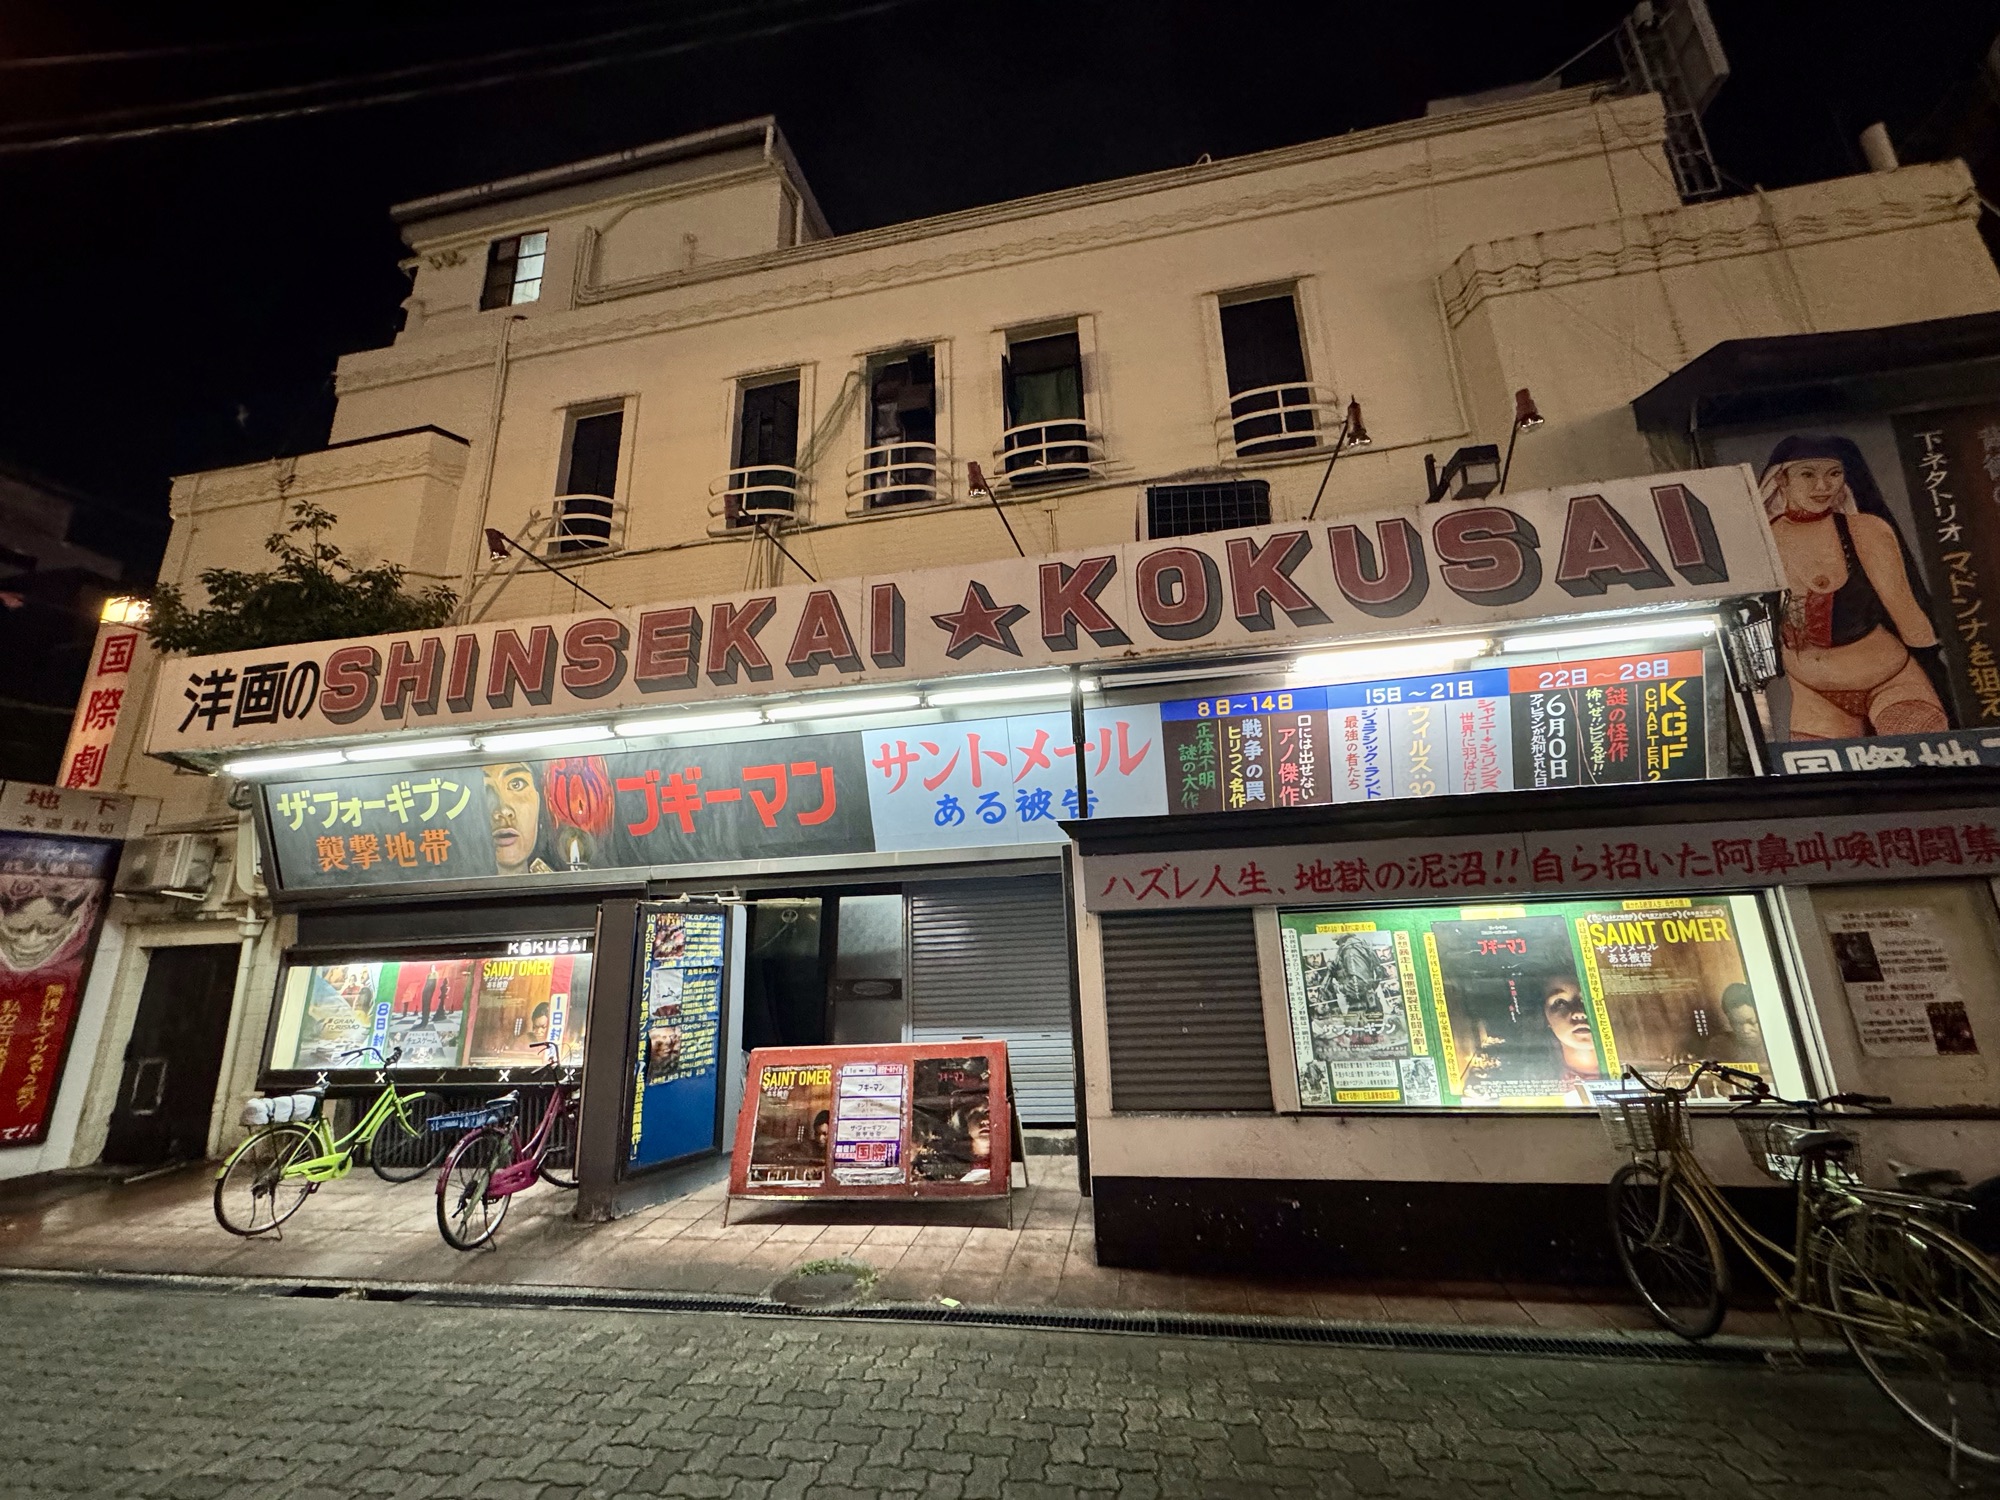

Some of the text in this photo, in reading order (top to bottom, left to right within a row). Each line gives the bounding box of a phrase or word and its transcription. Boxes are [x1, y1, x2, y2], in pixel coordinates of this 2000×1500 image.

[178, 482, 1731, 734] 洋画の SHINSEKAI KOKUSAI
[872, 721, 1152, 795] サントメール
[1195, 721, 1217, 790] 正体不明
[1297, 714, 1315, 800] 口には出せない
[1343, 715, 1360, 790] 最強の者たち
[1361, 707, 1382, 799] ジュラシック・ランド
[1459, 711, 1479, 792] 世界に羽ばたけ
[1529, 693, 1548, 787] アイヒマンが処刑された日
[1604, 686, 1630, 763] 謎の怪作
[1177, 743, 1200, 810] 謎の大作
[1228, 726, 1247, 809] ヒリつく名作
[1241, 718, 1266, 803] 戦争の罠
[1278, 727, 1300, 806] アノ傑作
[24, 788, 122, 815] 地下
[276, 777, 472, 832] ザ・フォーギブン
[616, 760, 837, 837] ブギーマン
[933, 786, 1100, 828] ある被告
[315, 828, 453, 872] 襲撃地帯
[507, 938, 588, 956] KOKUSAI
[1476, 938, 1527, 955] ブギーマン
[1589, 917, 1731, 947] SAINT OMER
[1595, 943, 1660, 954] サントメール
[1607, 951, 1653, 963] ある被告
[483, 959, 551, 977] SAINT OMER
[762, 1069, 832, 1088] SAINT OMER
[856, 1143, 887, 1161] 国際
